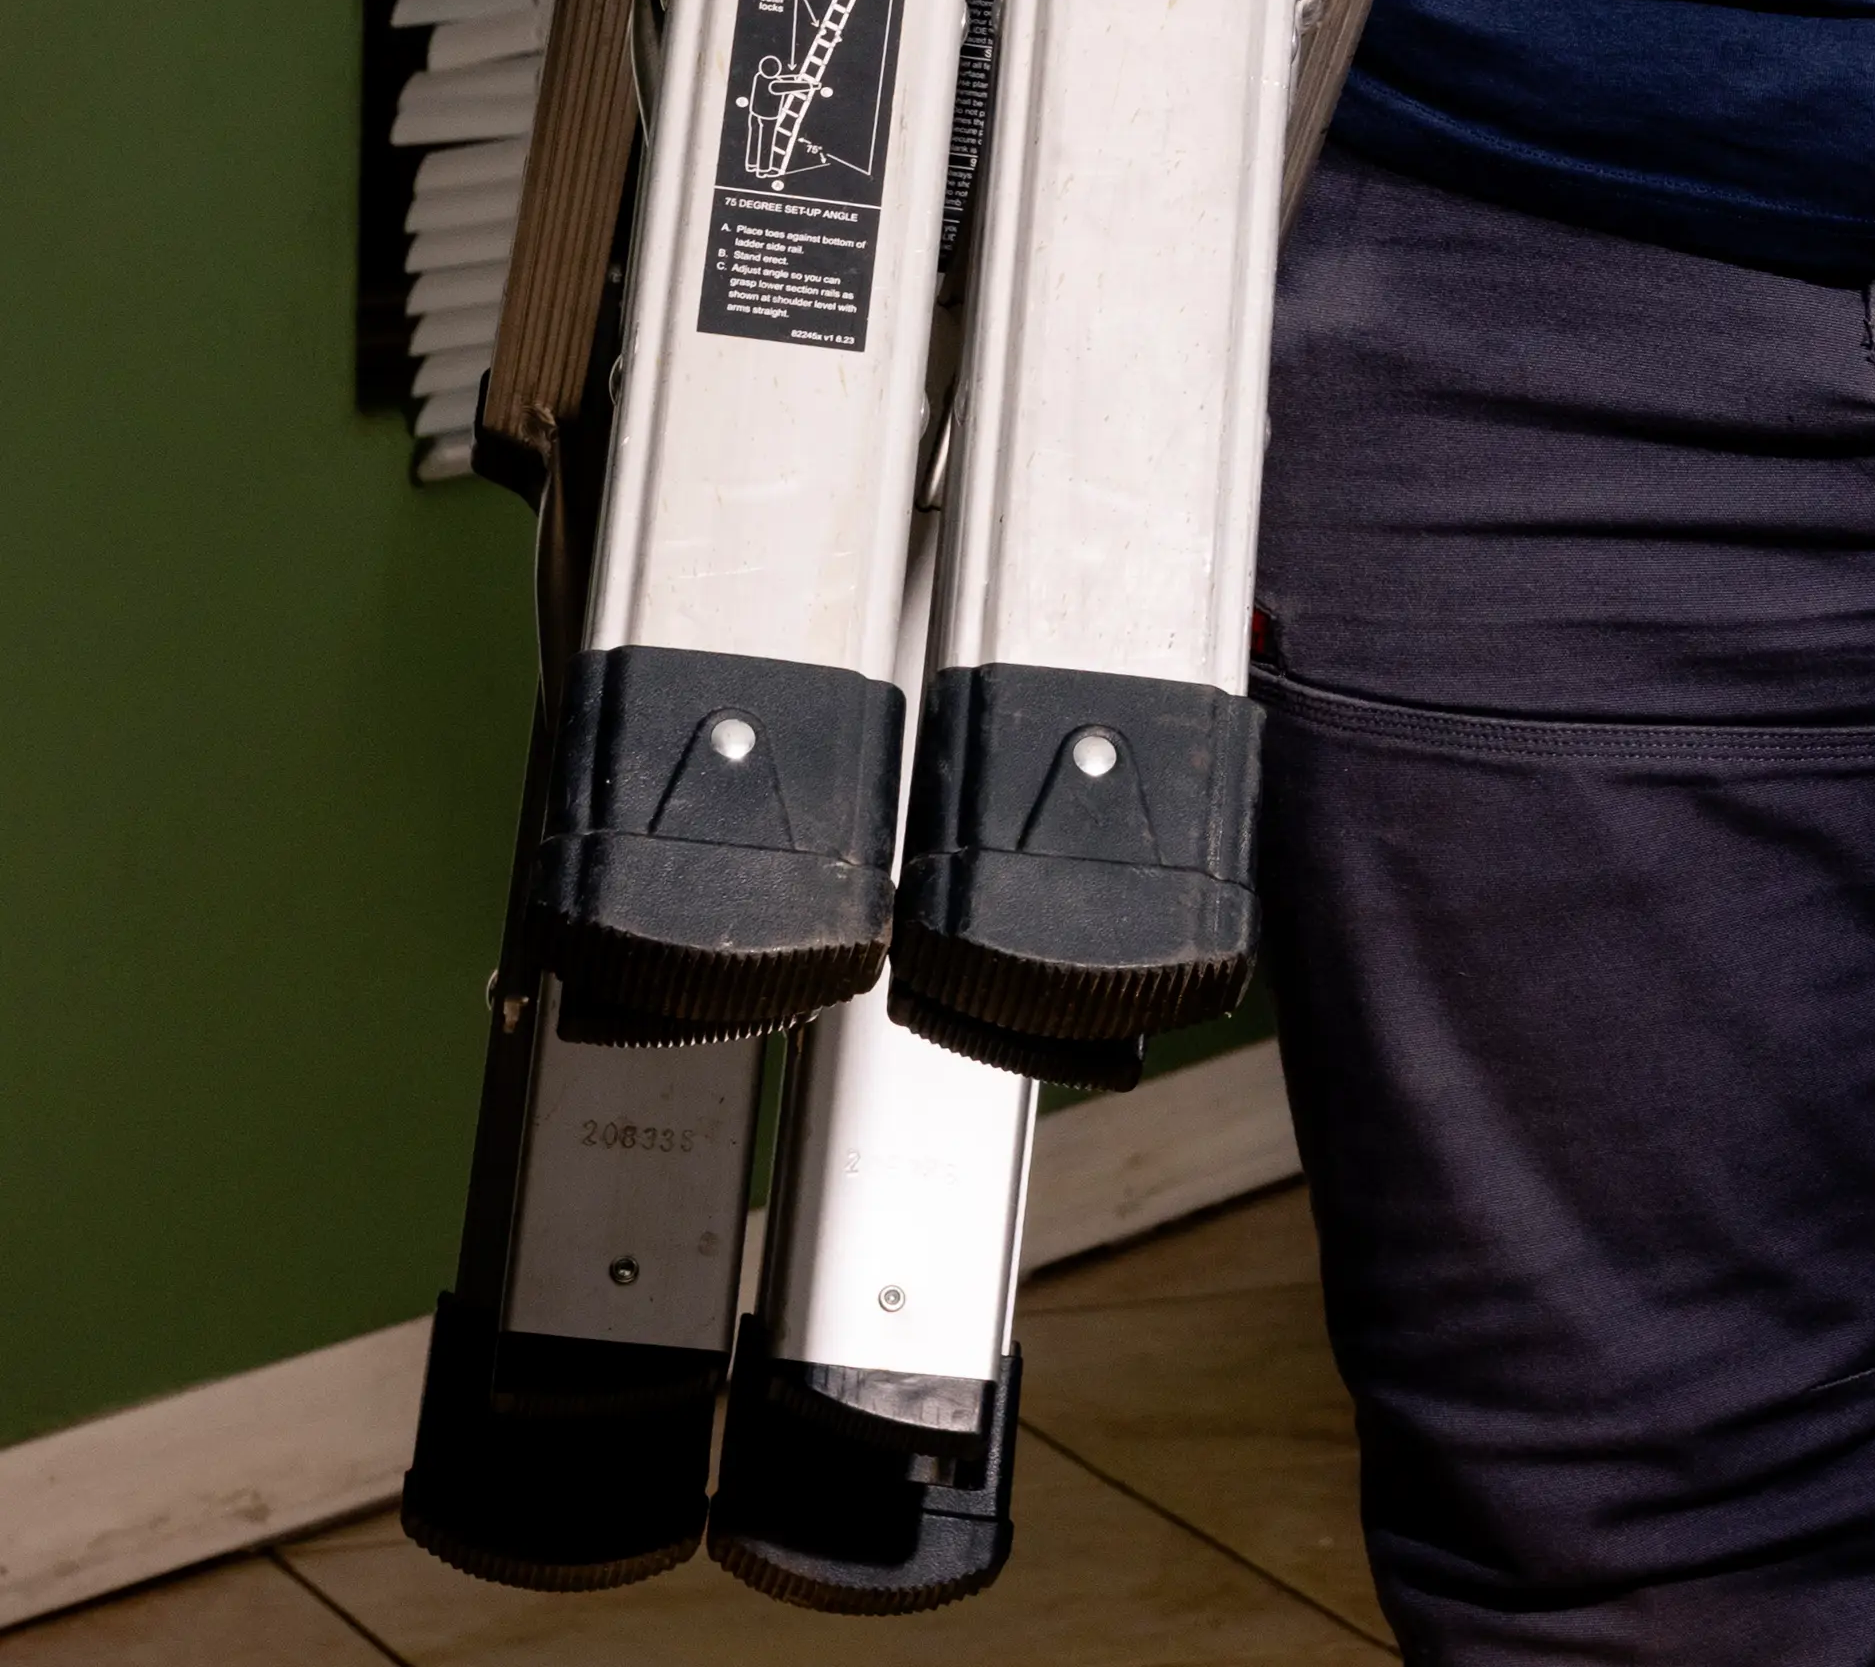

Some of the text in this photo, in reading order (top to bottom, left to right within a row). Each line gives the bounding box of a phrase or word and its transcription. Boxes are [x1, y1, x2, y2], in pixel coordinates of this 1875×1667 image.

[758, 1, 784, 13] locks
[724, 196, 858, 222] 75 DEGREE SET-UP ANGLE
[734, 237, 765, 250] ladder
[765, 241, 786, 252] side
[735, 224, 763, 236] Place
[764, 228, 785, 239] toes
[785, 230, 821, 245] against
[821, 235, 855, 248] bottom
[855, 239, 866, 249] of
[733, 249, 761, 262] Stand
[730, 263, 761, 277] Adjust
[761, 267, 789, 280] angle
[790, 271, 803, 281] so
[803, 273, 822, 285] you
[822, 275, 841, 285] can
[729, 277, 854, 300] grasp lower section rails as
[726, 302, 751, 313] arms
[728, 289, 857, 313] shown at shoulder level with
